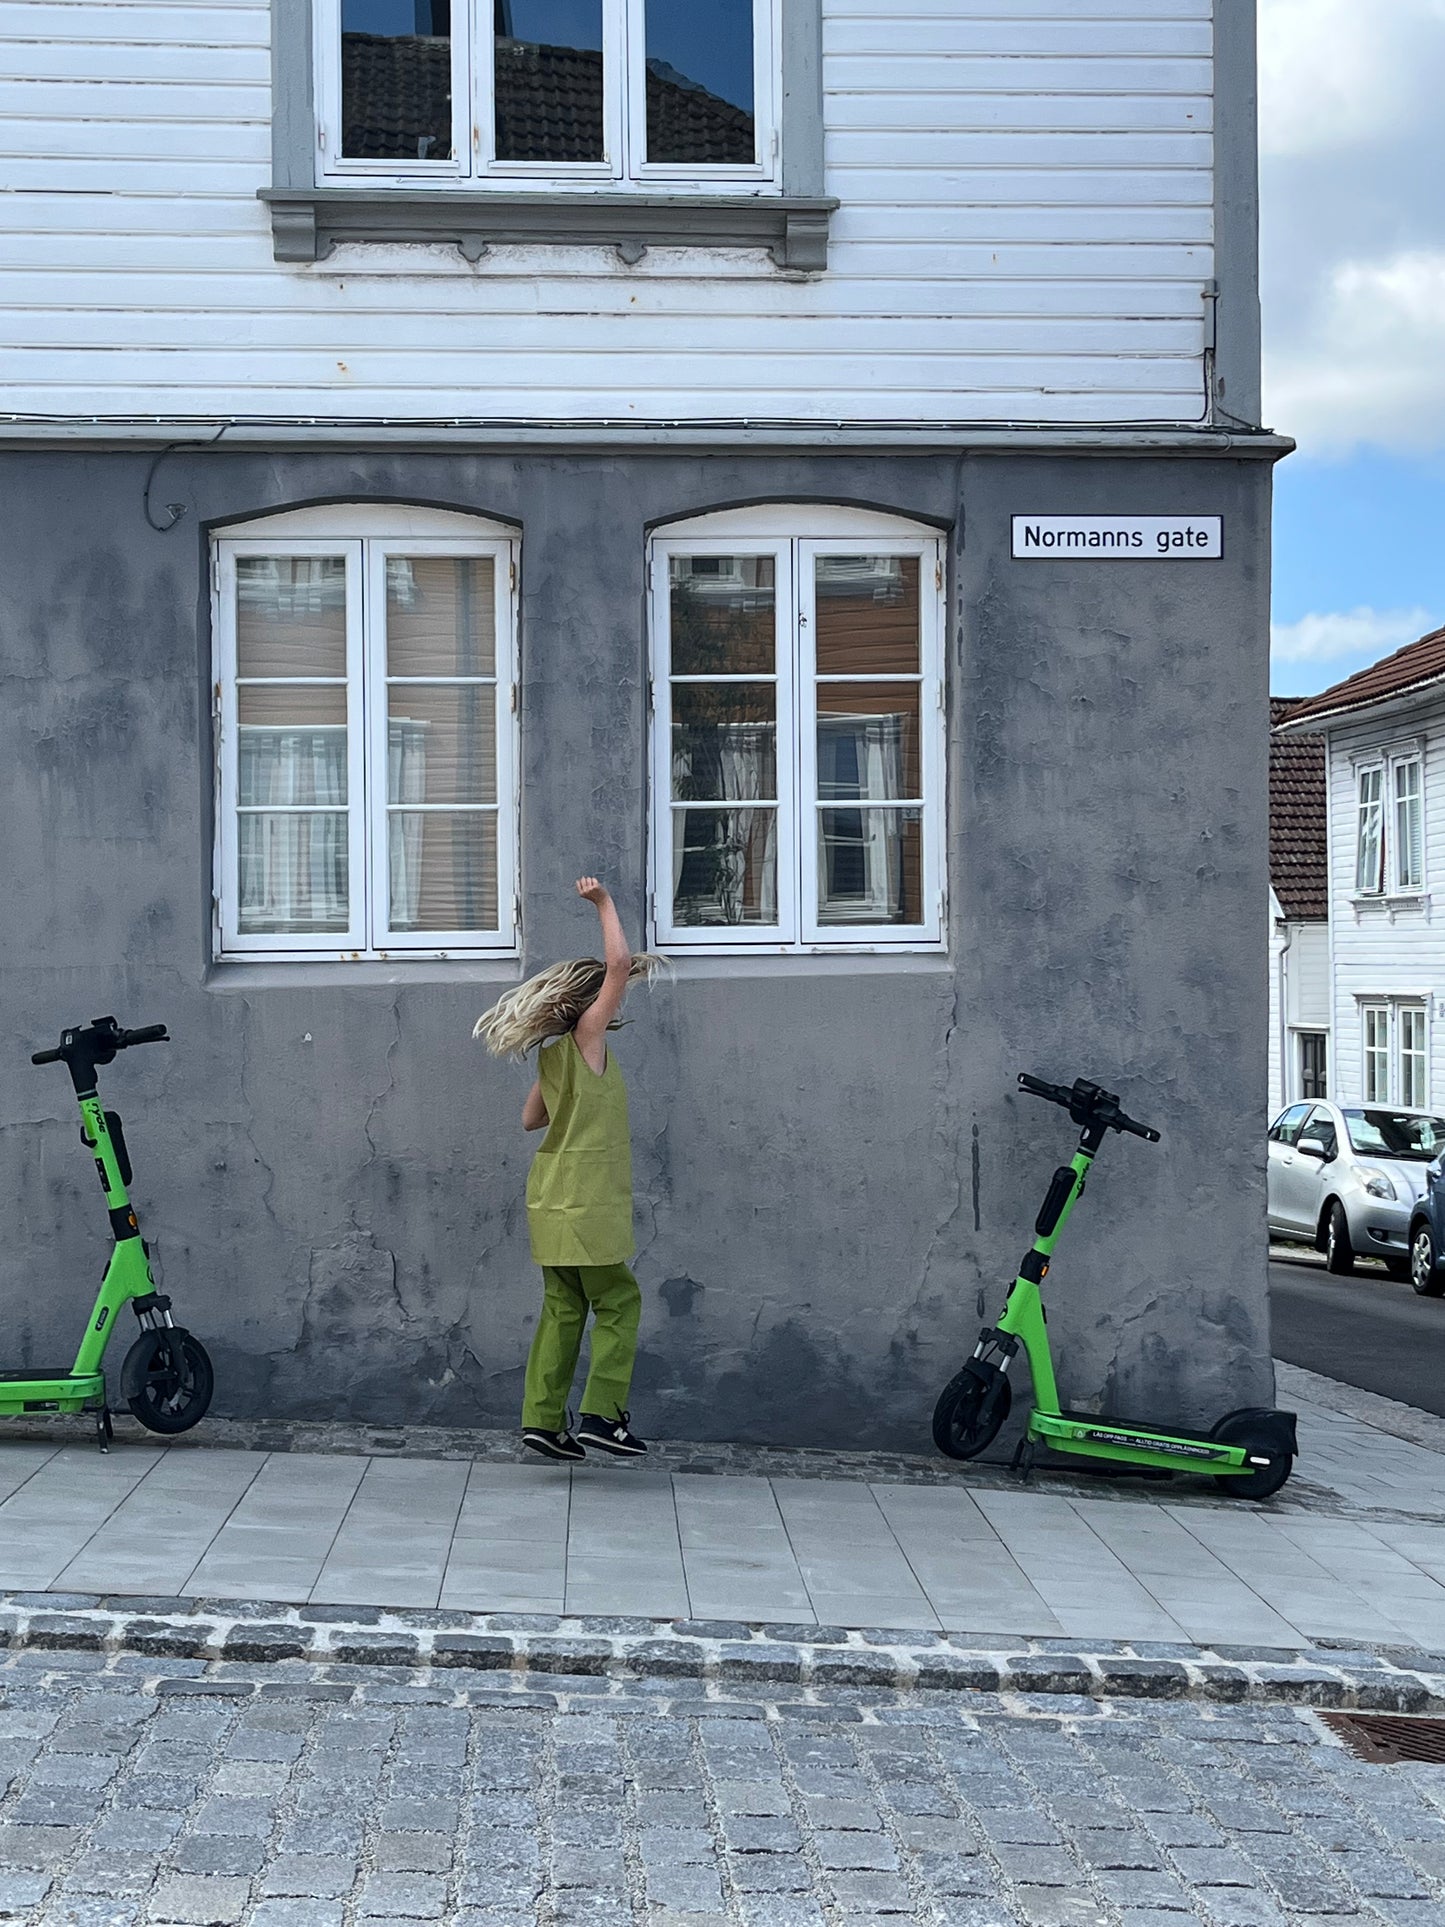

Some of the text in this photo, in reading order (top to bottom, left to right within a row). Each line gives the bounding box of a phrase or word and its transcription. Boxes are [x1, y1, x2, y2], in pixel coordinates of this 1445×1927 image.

[1024, 525, 1209, 553] Normanns gate
[88, 1102, 106, 1133] ryde
[613, 1427, 628, 1442] N
